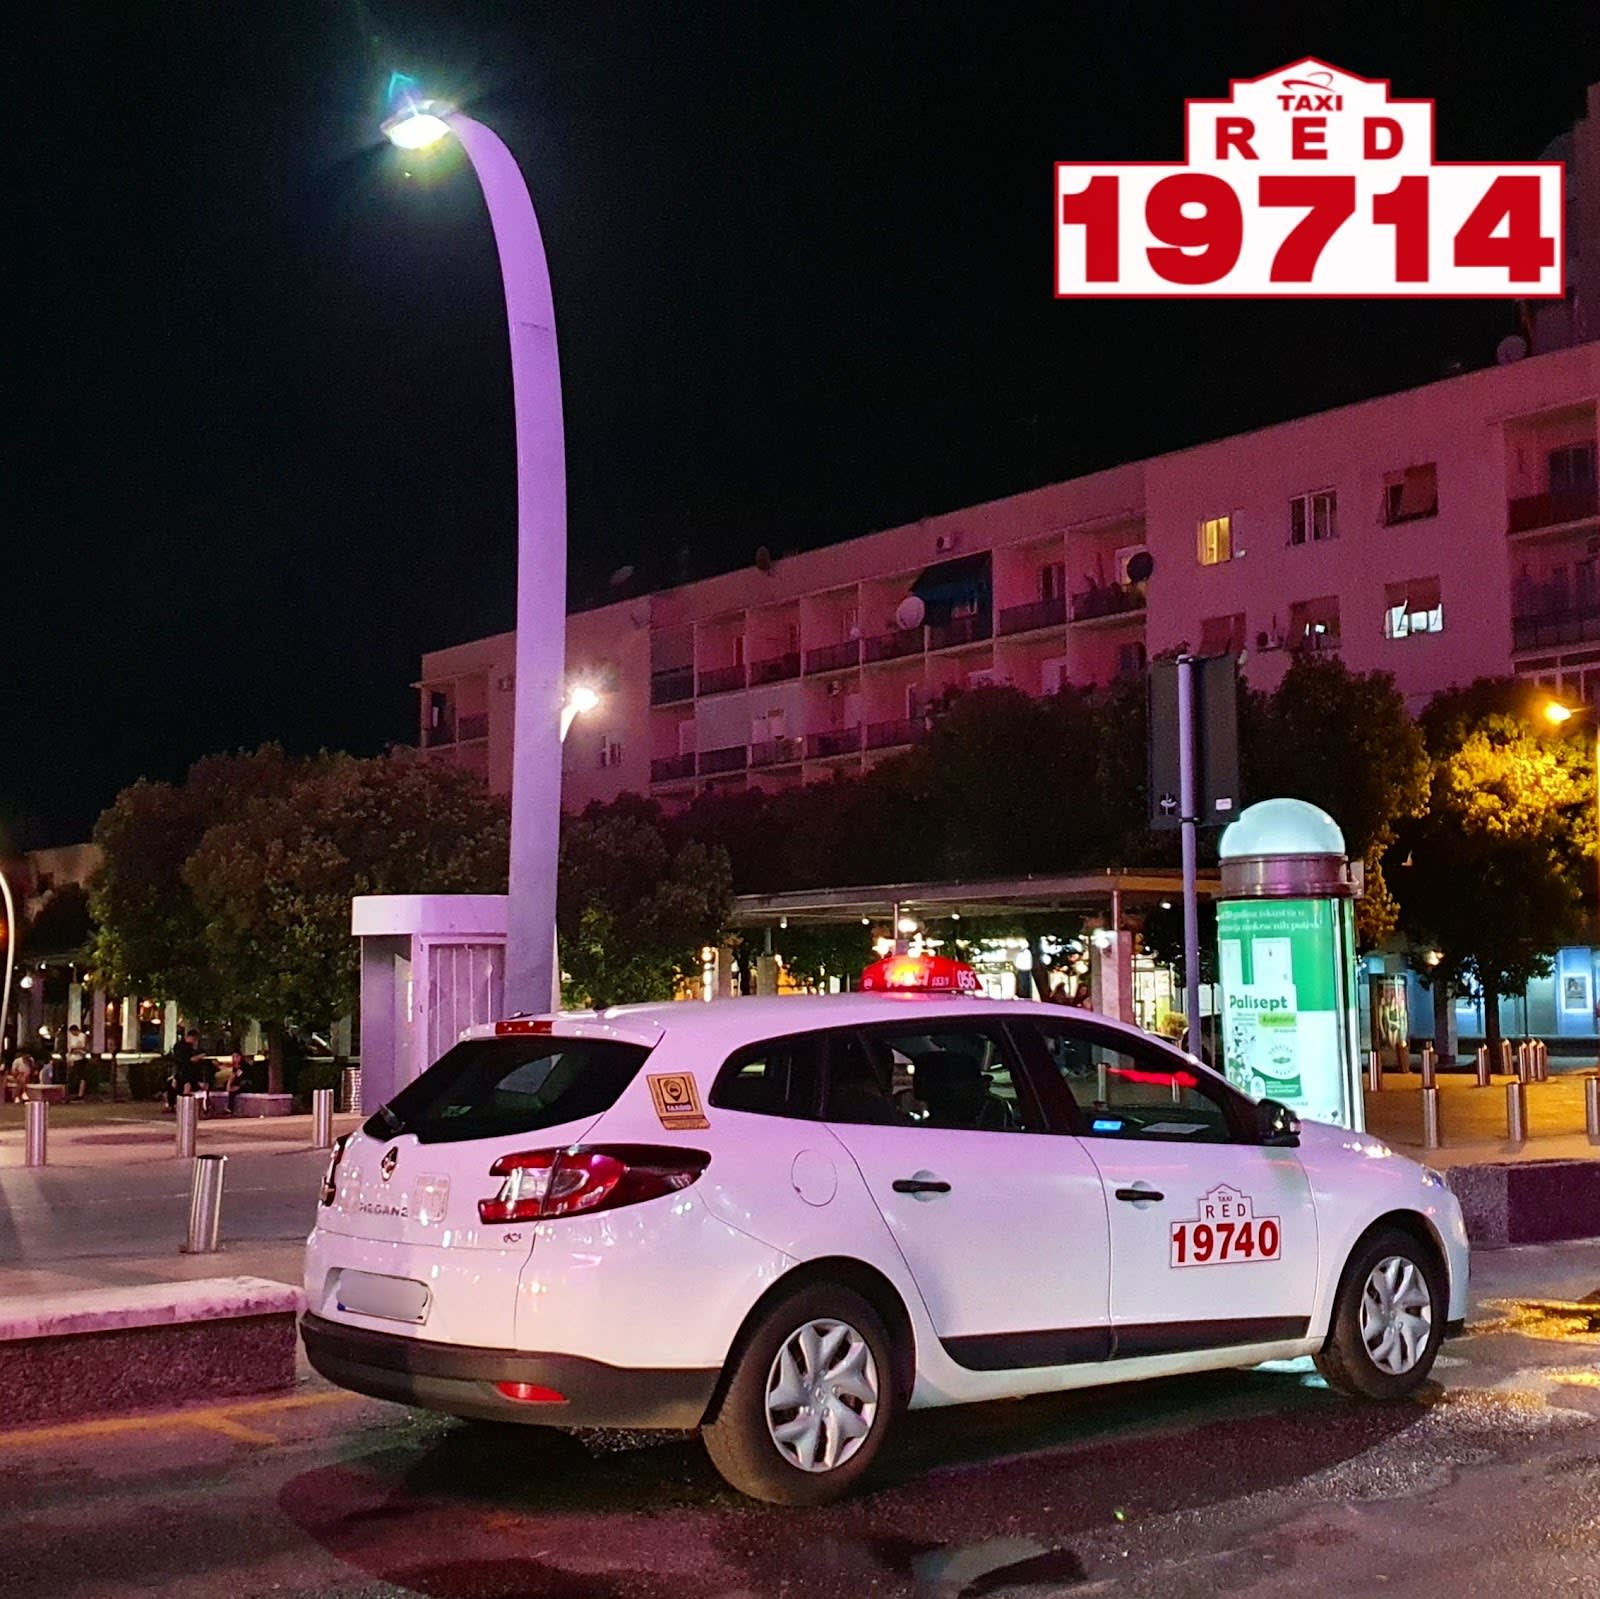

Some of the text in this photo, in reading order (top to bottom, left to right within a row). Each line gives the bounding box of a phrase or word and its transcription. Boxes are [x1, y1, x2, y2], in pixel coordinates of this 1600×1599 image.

[1229, 994, 1288, 1011] Palisept
[1206, 1204, 1246, 1218] RED
[1173, 1220, 1278, 1263] 19740
